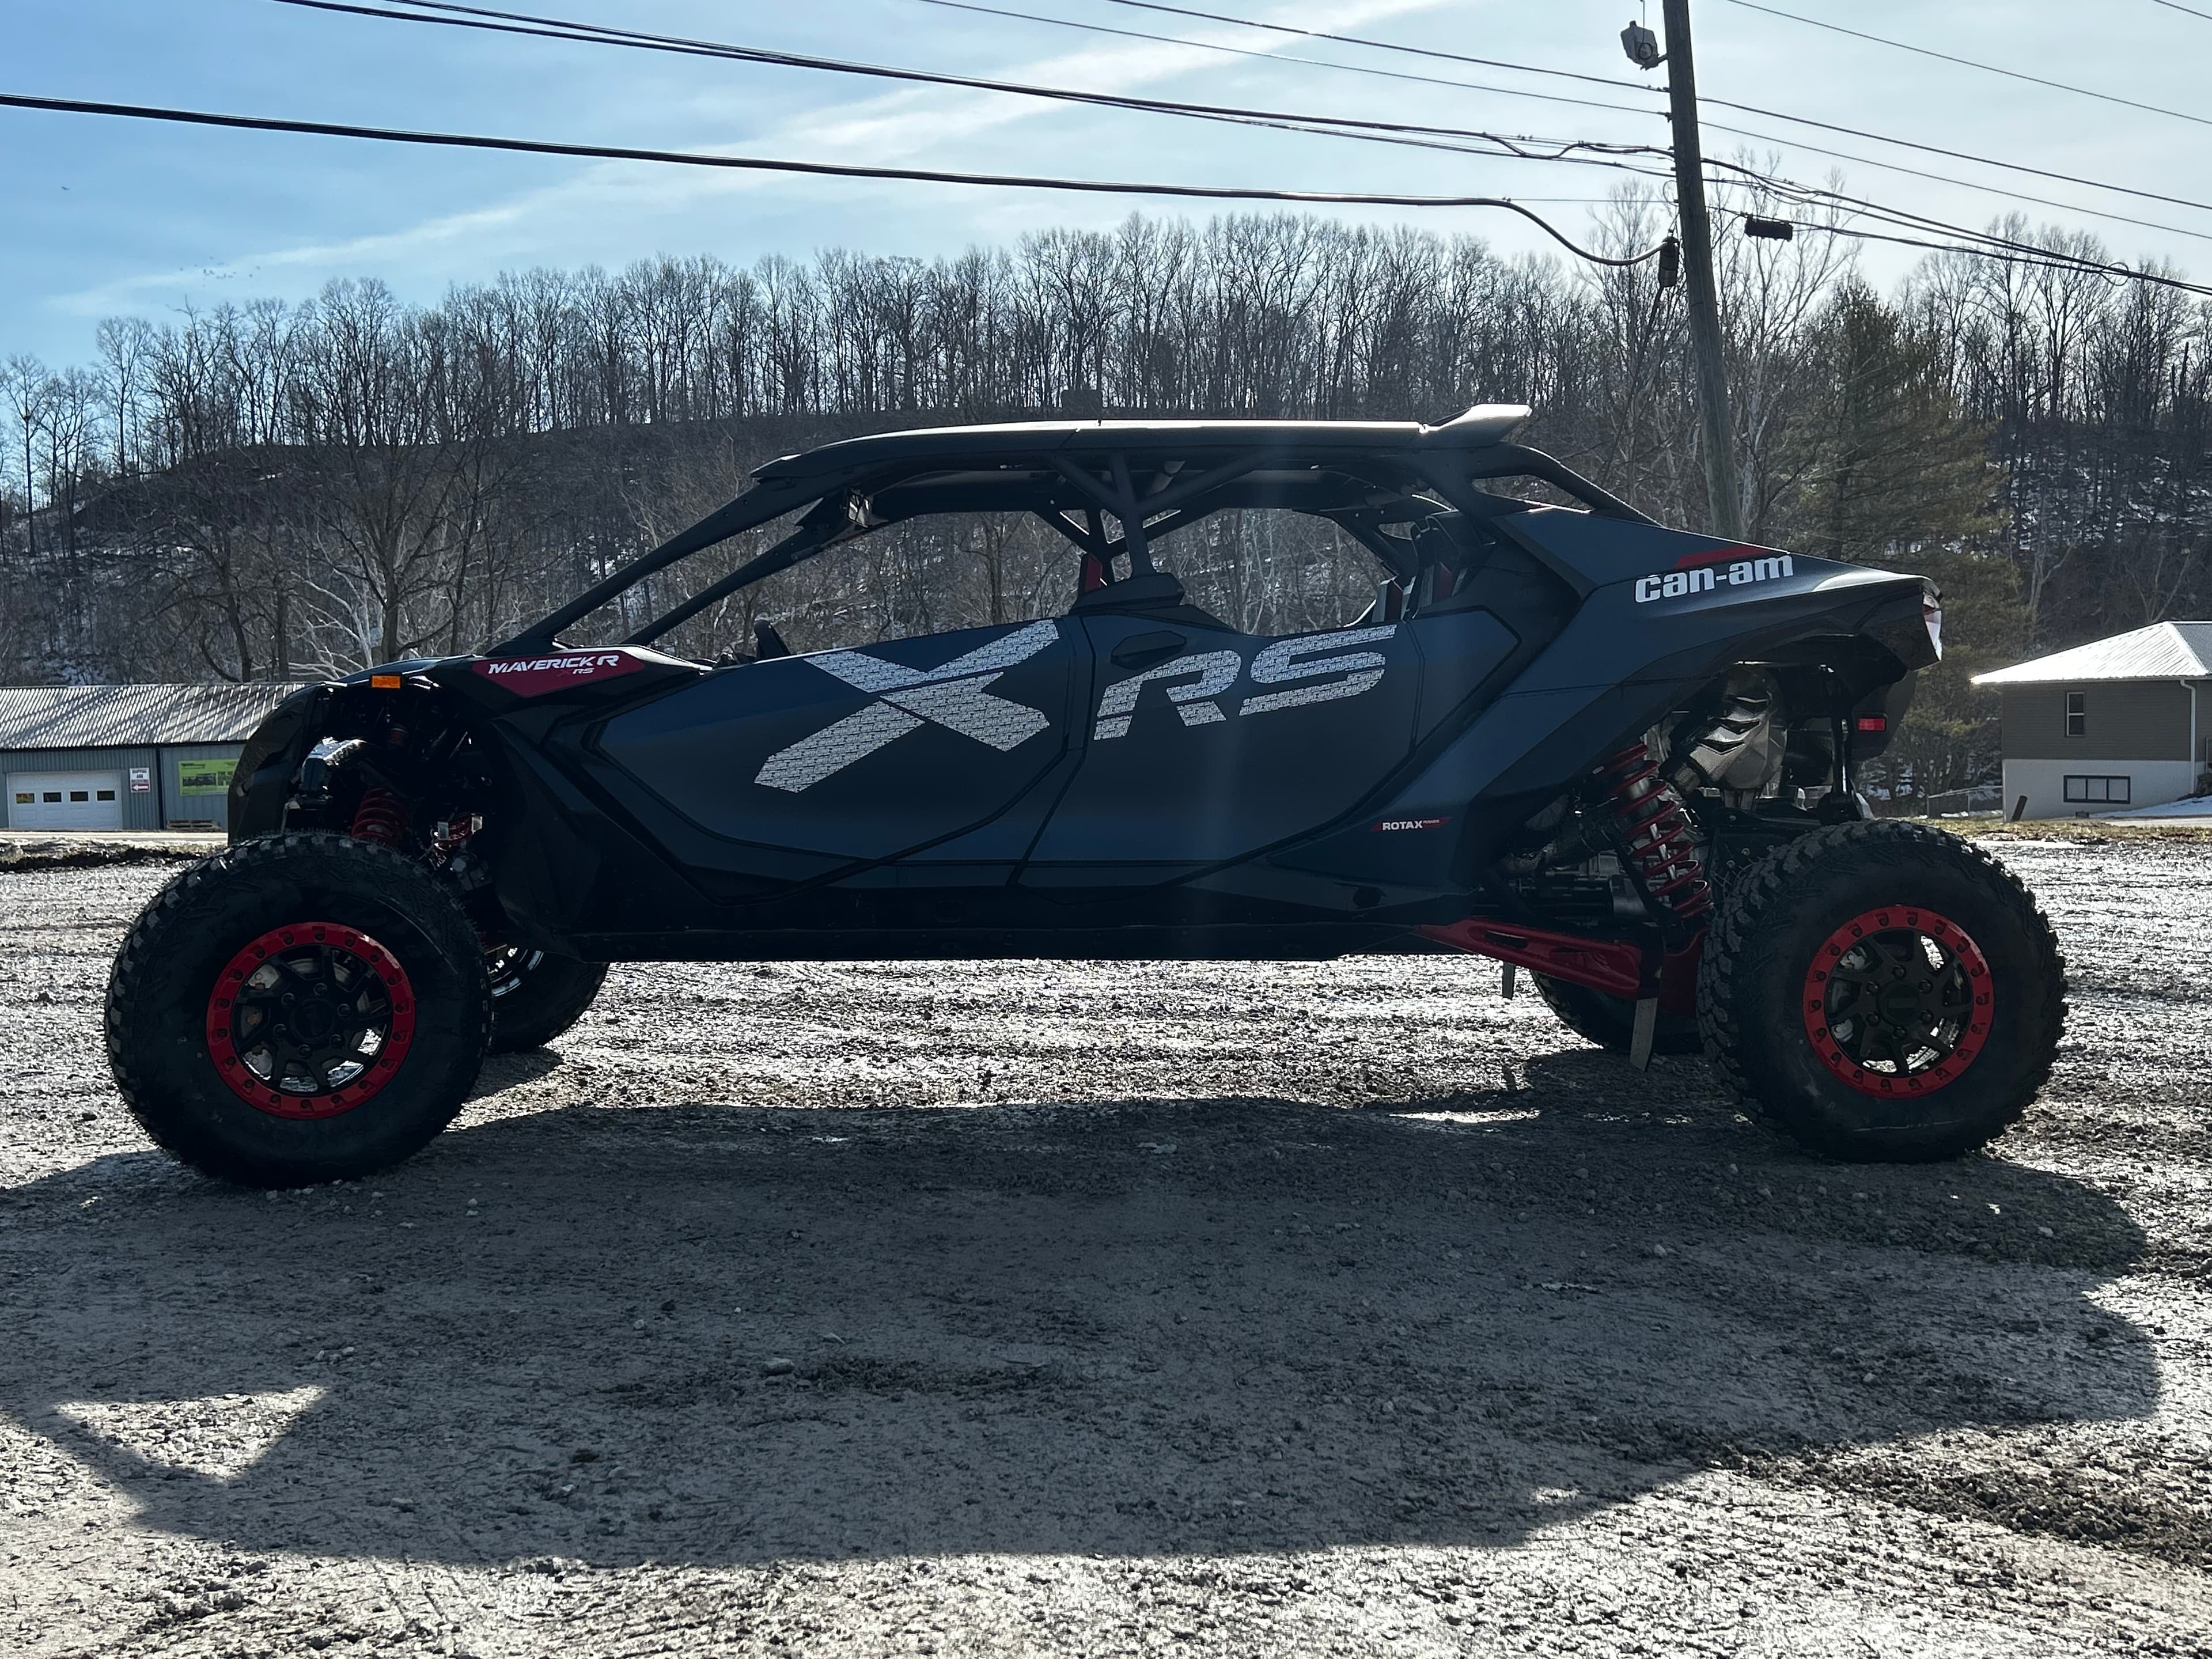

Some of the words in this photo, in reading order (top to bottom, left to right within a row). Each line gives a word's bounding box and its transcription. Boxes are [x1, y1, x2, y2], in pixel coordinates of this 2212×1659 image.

[1635, 554, 1794, 603] can-am
[488, 656, 596, 674] MAVERICK
[596, 654, 620, 666] R
[754, 618, 1060, 793] X
[1093, 624, 1397, 741] RS
[1382, 820, 1423, 831] ROTAX
